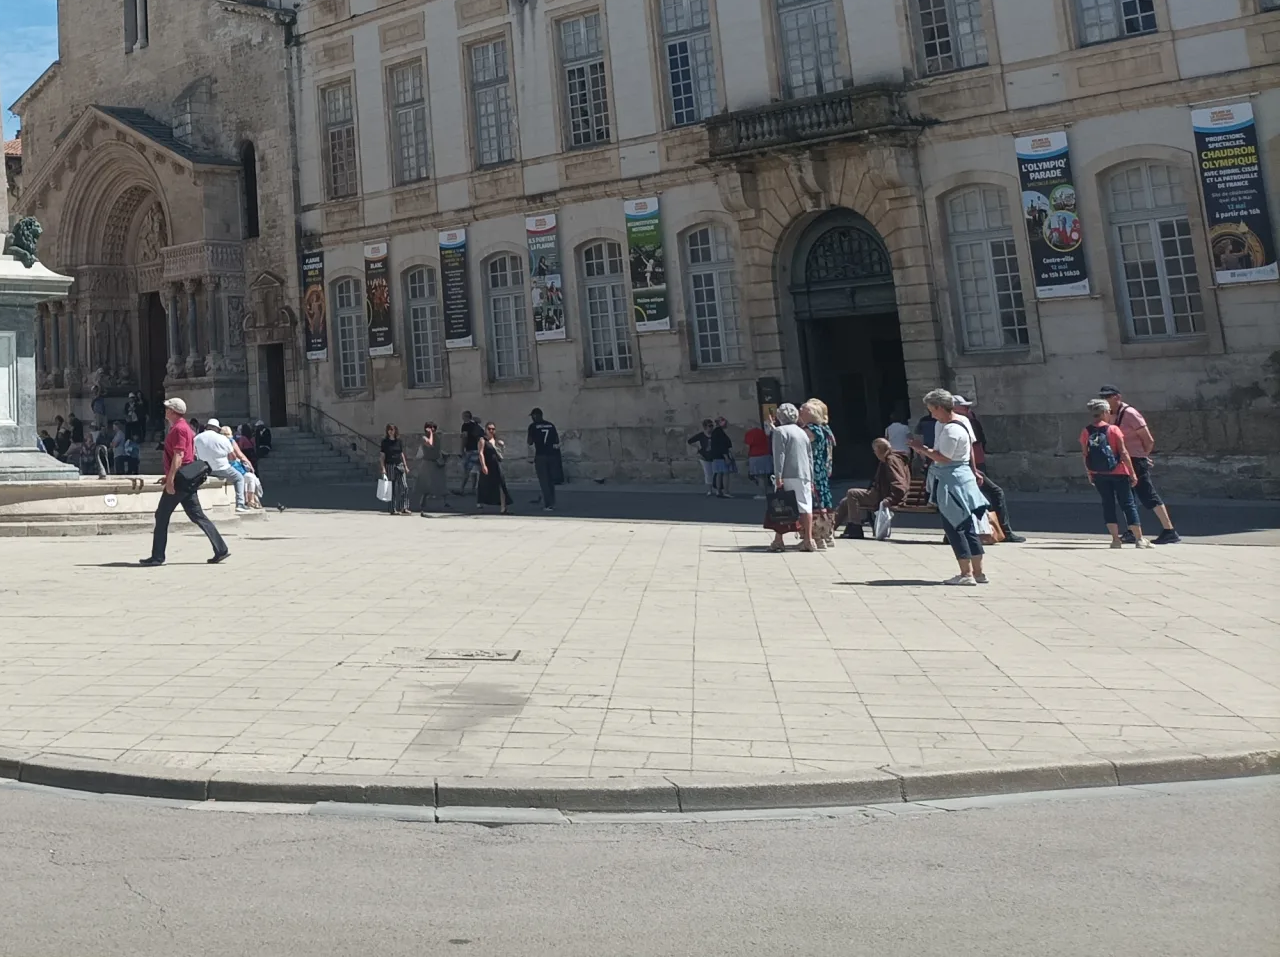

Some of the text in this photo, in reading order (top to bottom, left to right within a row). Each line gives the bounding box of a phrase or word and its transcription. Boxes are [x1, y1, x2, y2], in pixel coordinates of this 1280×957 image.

[1205, 133, 1246, 142] PROJECTIONS,
[1208, 140, 1246, 149] SPECTACLES,
[1201, 146, 1255, 159] CHAUDRON
[1021, 159, 1067, 172] L'OLYMPIQ'
[1202, 156, 1258, 169] OLYMPIQUE
[1029, 170, 1062, 180] PARADE
[1223, 173, 1258, 181] PATROUILLE
[1220, 211, 1239, 219] partir
[541, 429, 549, 444] 7
